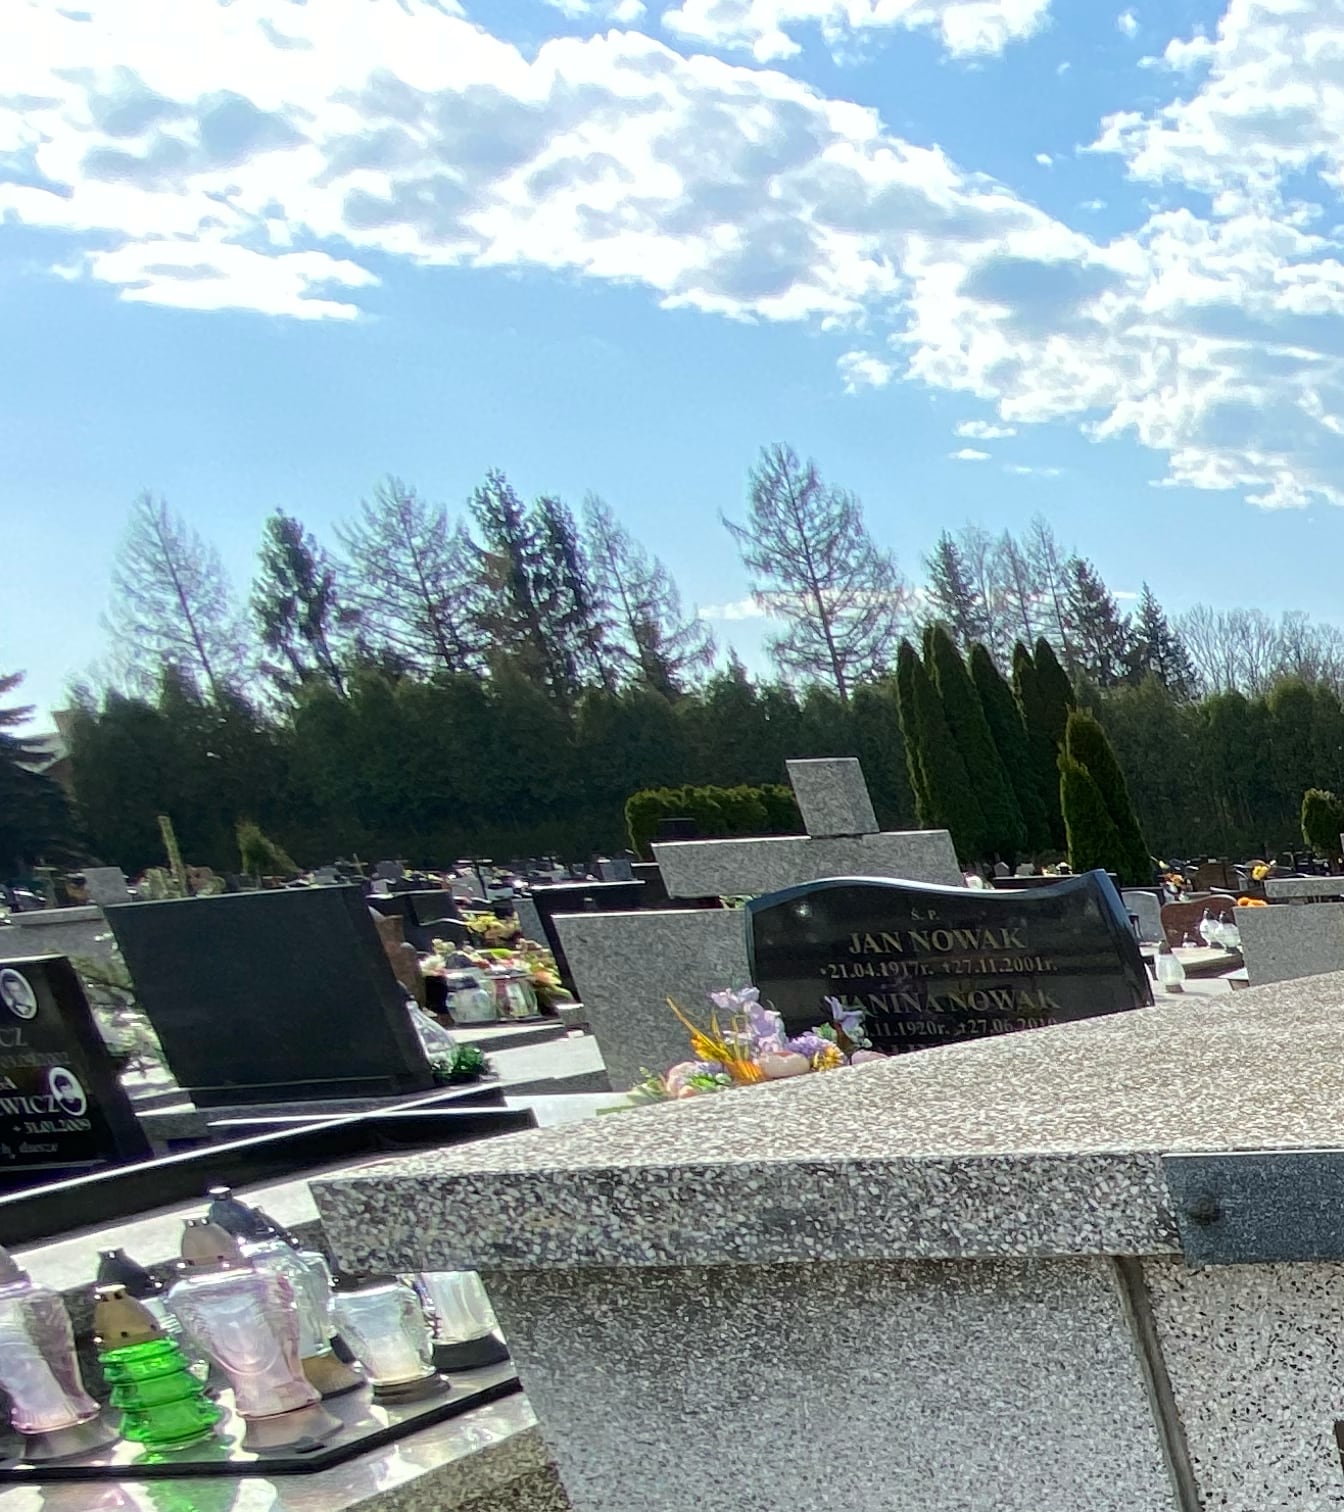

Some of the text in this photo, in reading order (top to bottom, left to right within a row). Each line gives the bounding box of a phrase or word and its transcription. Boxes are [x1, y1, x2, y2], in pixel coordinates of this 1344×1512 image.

[850, 927, 1027, 954] JAN NOWAK
[951, 988, 1061, 1012] NOWAK
[0, 1094, 61, 1116] WICZ
